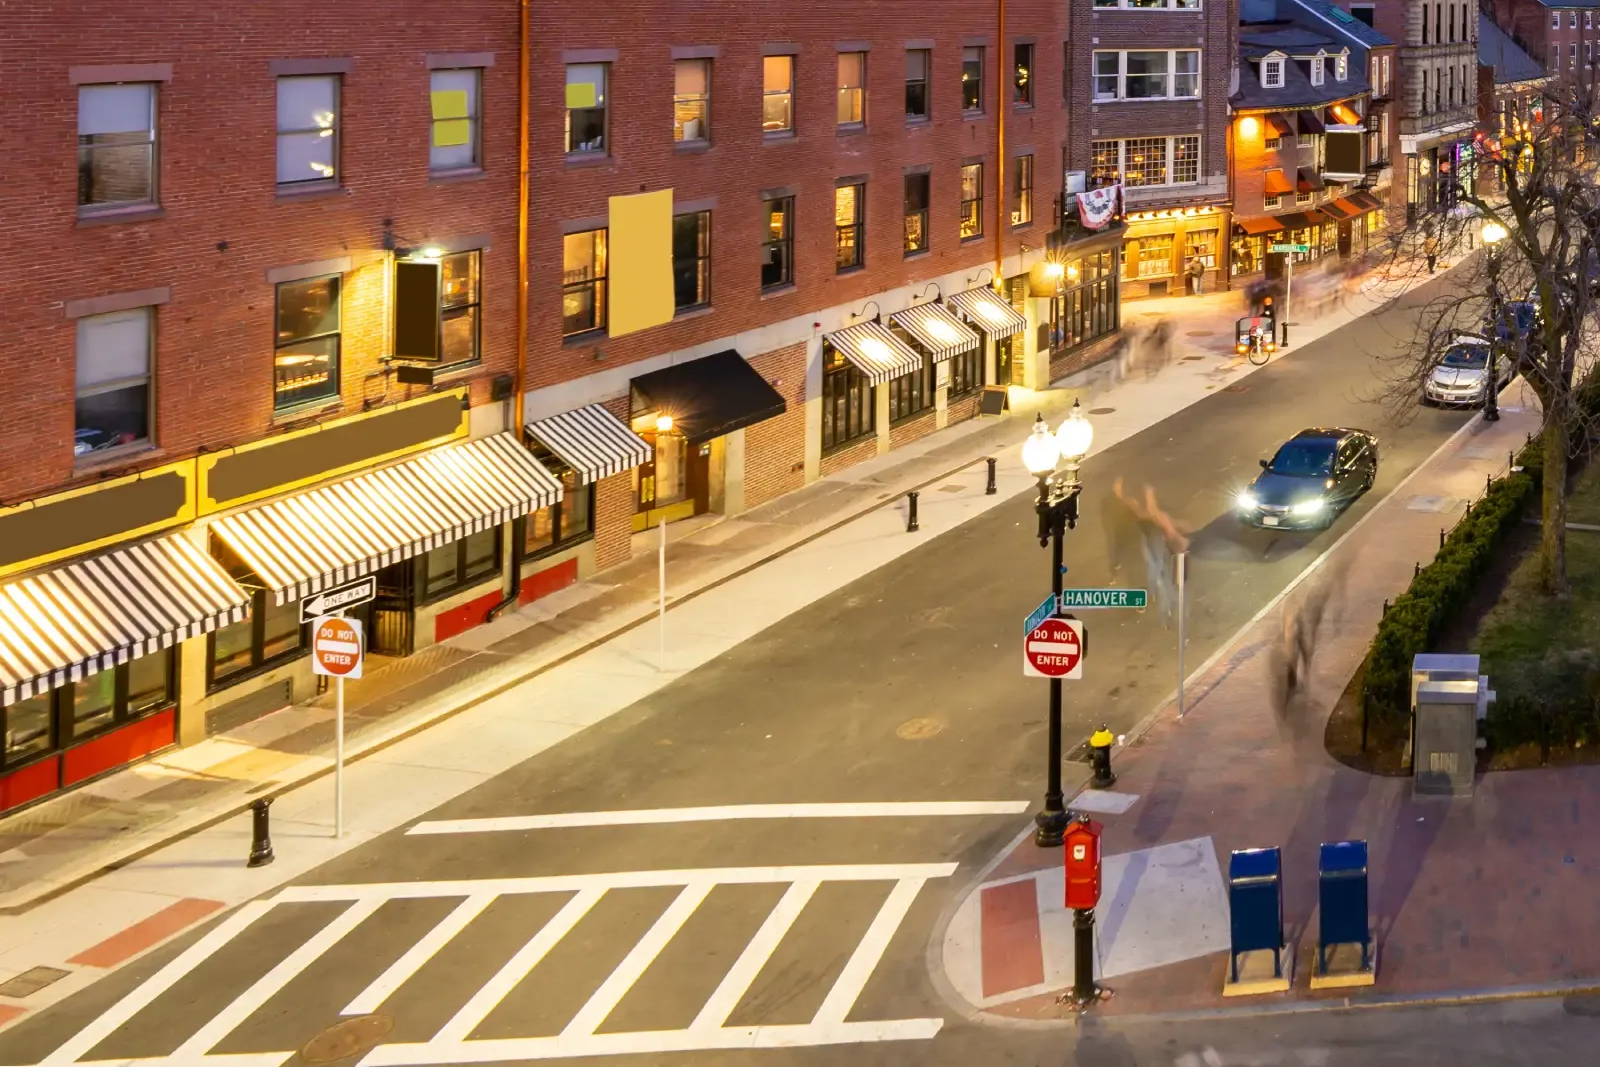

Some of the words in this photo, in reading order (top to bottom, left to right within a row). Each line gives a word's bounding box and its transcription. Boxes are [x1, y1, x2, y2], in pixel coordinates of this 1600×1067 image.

[324, 594, 344, 607] ONE
[347, 586, 367, 598] WAY
[1066, 592, 1127, 605] HANOVER
[321, 628, 334, 638] DO
[337, 630, 353, 640] NOT
[1034, 630, 1048, 639] DO
[1053, 631, 1073, 641] NOT
[323, 654, 351, 665] ENTER
[1037, 655, 1069, 666] ENTER
